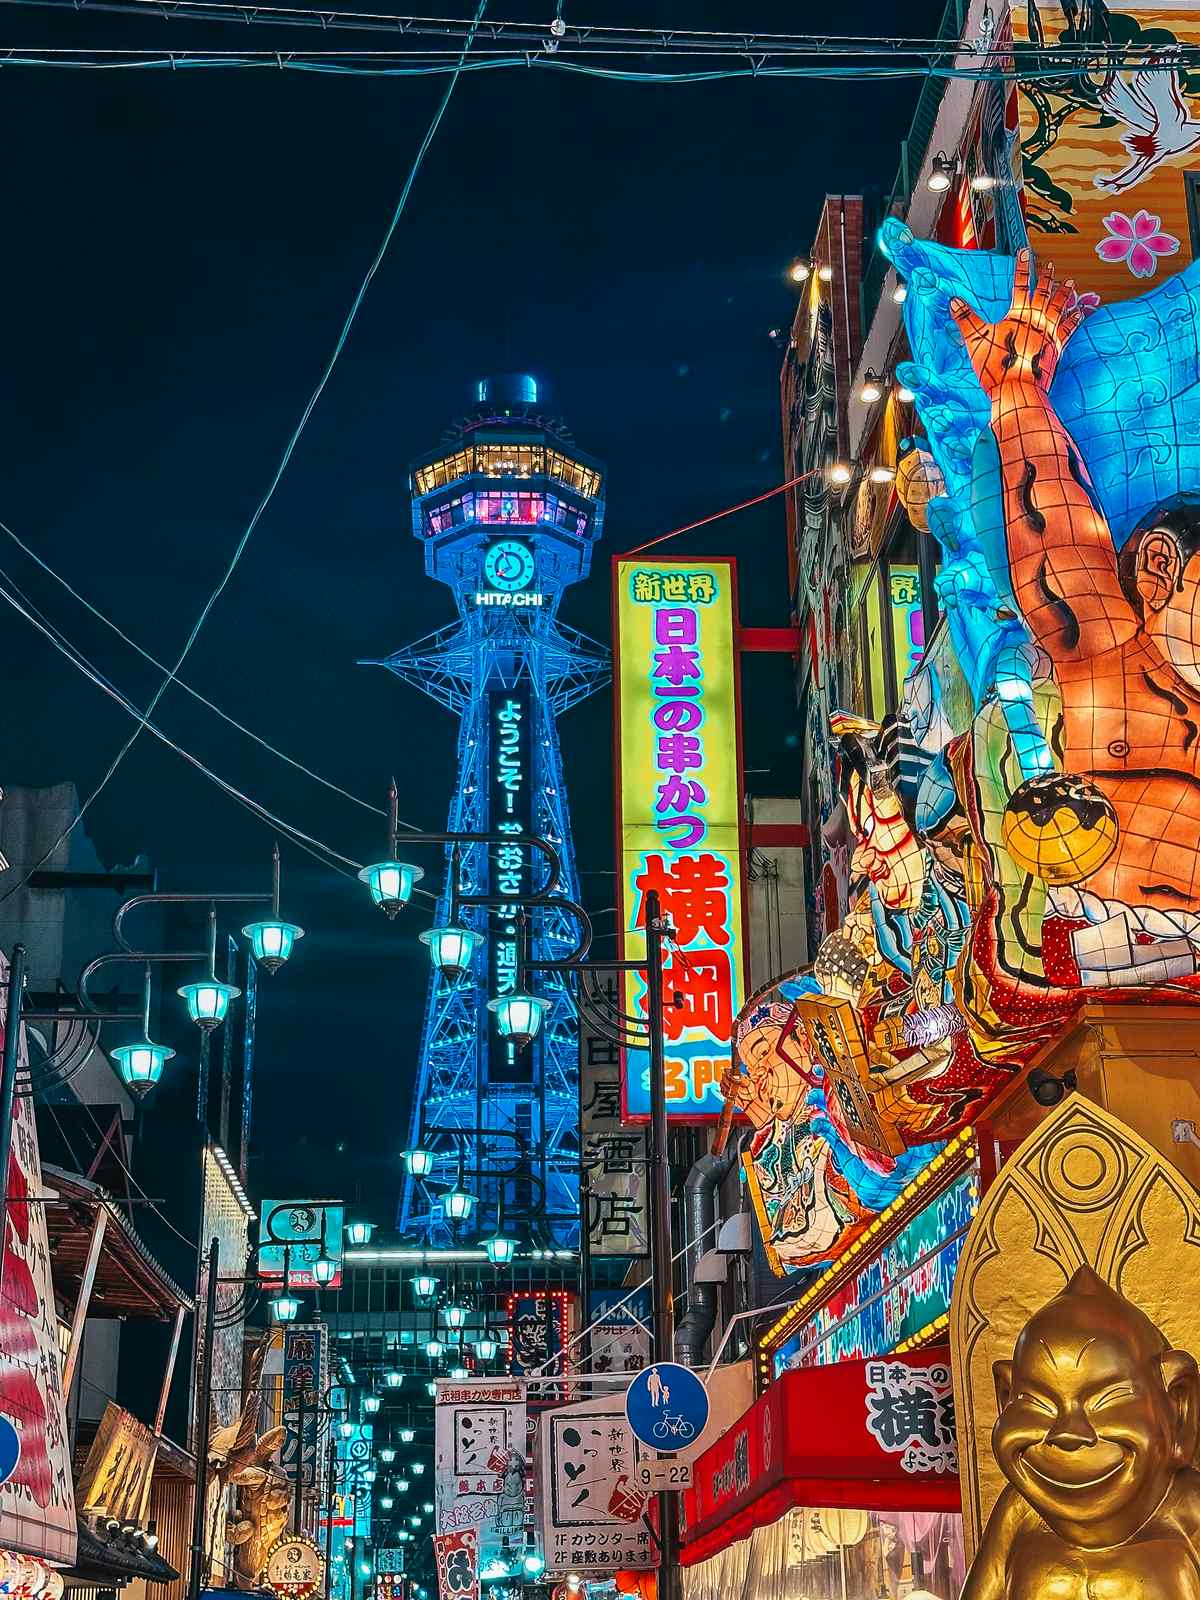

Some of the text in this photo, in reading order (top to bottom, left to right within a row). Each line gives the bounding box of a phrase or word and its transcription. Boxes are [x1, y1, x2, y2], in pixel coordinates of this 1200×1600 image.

[476, 592, 542, 607] HITACHI
[634, 572, 715, 603] 新世界
[653, 608, 706, 849] 日本一の串かつ
[634, 853, 733, 1041] 横綱
[286, 1332, 316, 1389] 麻雀
[870, 1365, 948, 1384] 日本一の
[440, 1390, 522, 1402] 元祖串カツ専門店
[608, 1427, 628, 1473] 新世界
[555, 1532, 649, 1546] 1F カウンター席
[554, 1551, 650, 1563] 2F 座敷あります
